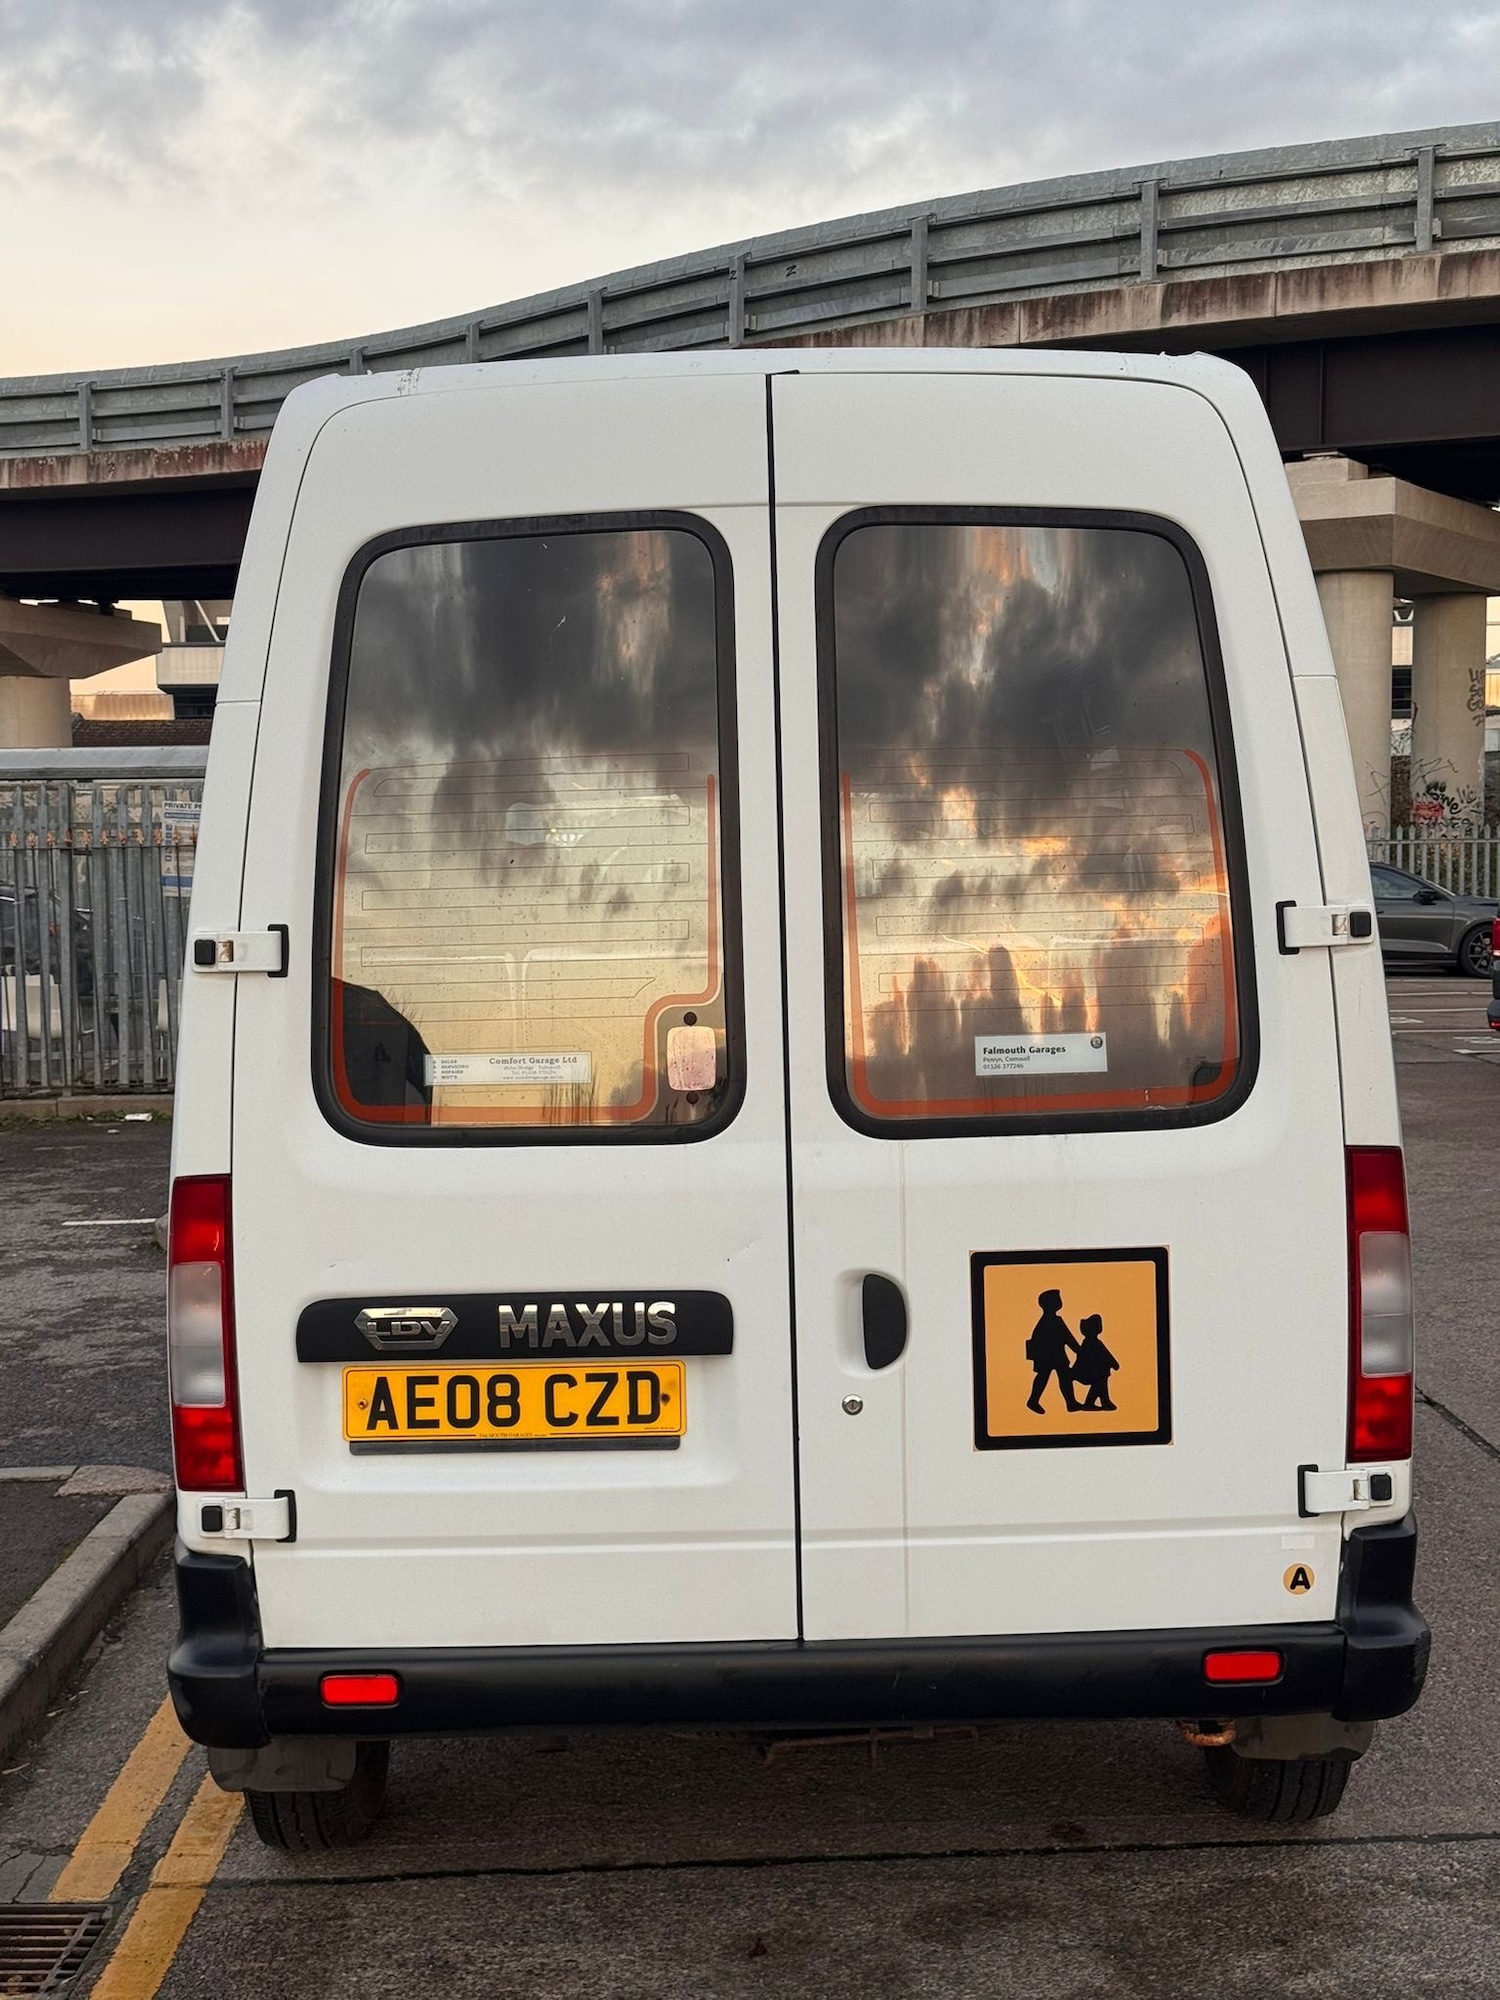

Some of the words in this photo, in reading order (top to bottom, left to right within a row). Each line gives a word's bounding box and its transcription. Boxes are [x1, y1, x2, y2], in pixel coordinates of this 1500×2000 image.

[489, 1057, 527, 1065] Comfort
[529, 1056, 560, 1065] Garage
[562, 1056, 578, 1064] Ltd
[983, 1046, 1026, 1054] Falmouth
[1029, 1046, 1066, 1055] Garages
[366, 1320, 451, 1336] LDV
[498, 1301, 679, 1349] MAXUS
[366, 1373, 520, 1430] AE08
[544, 1370, 661, 1428] CZD
[1290, 1566, 1311, 1590] A
